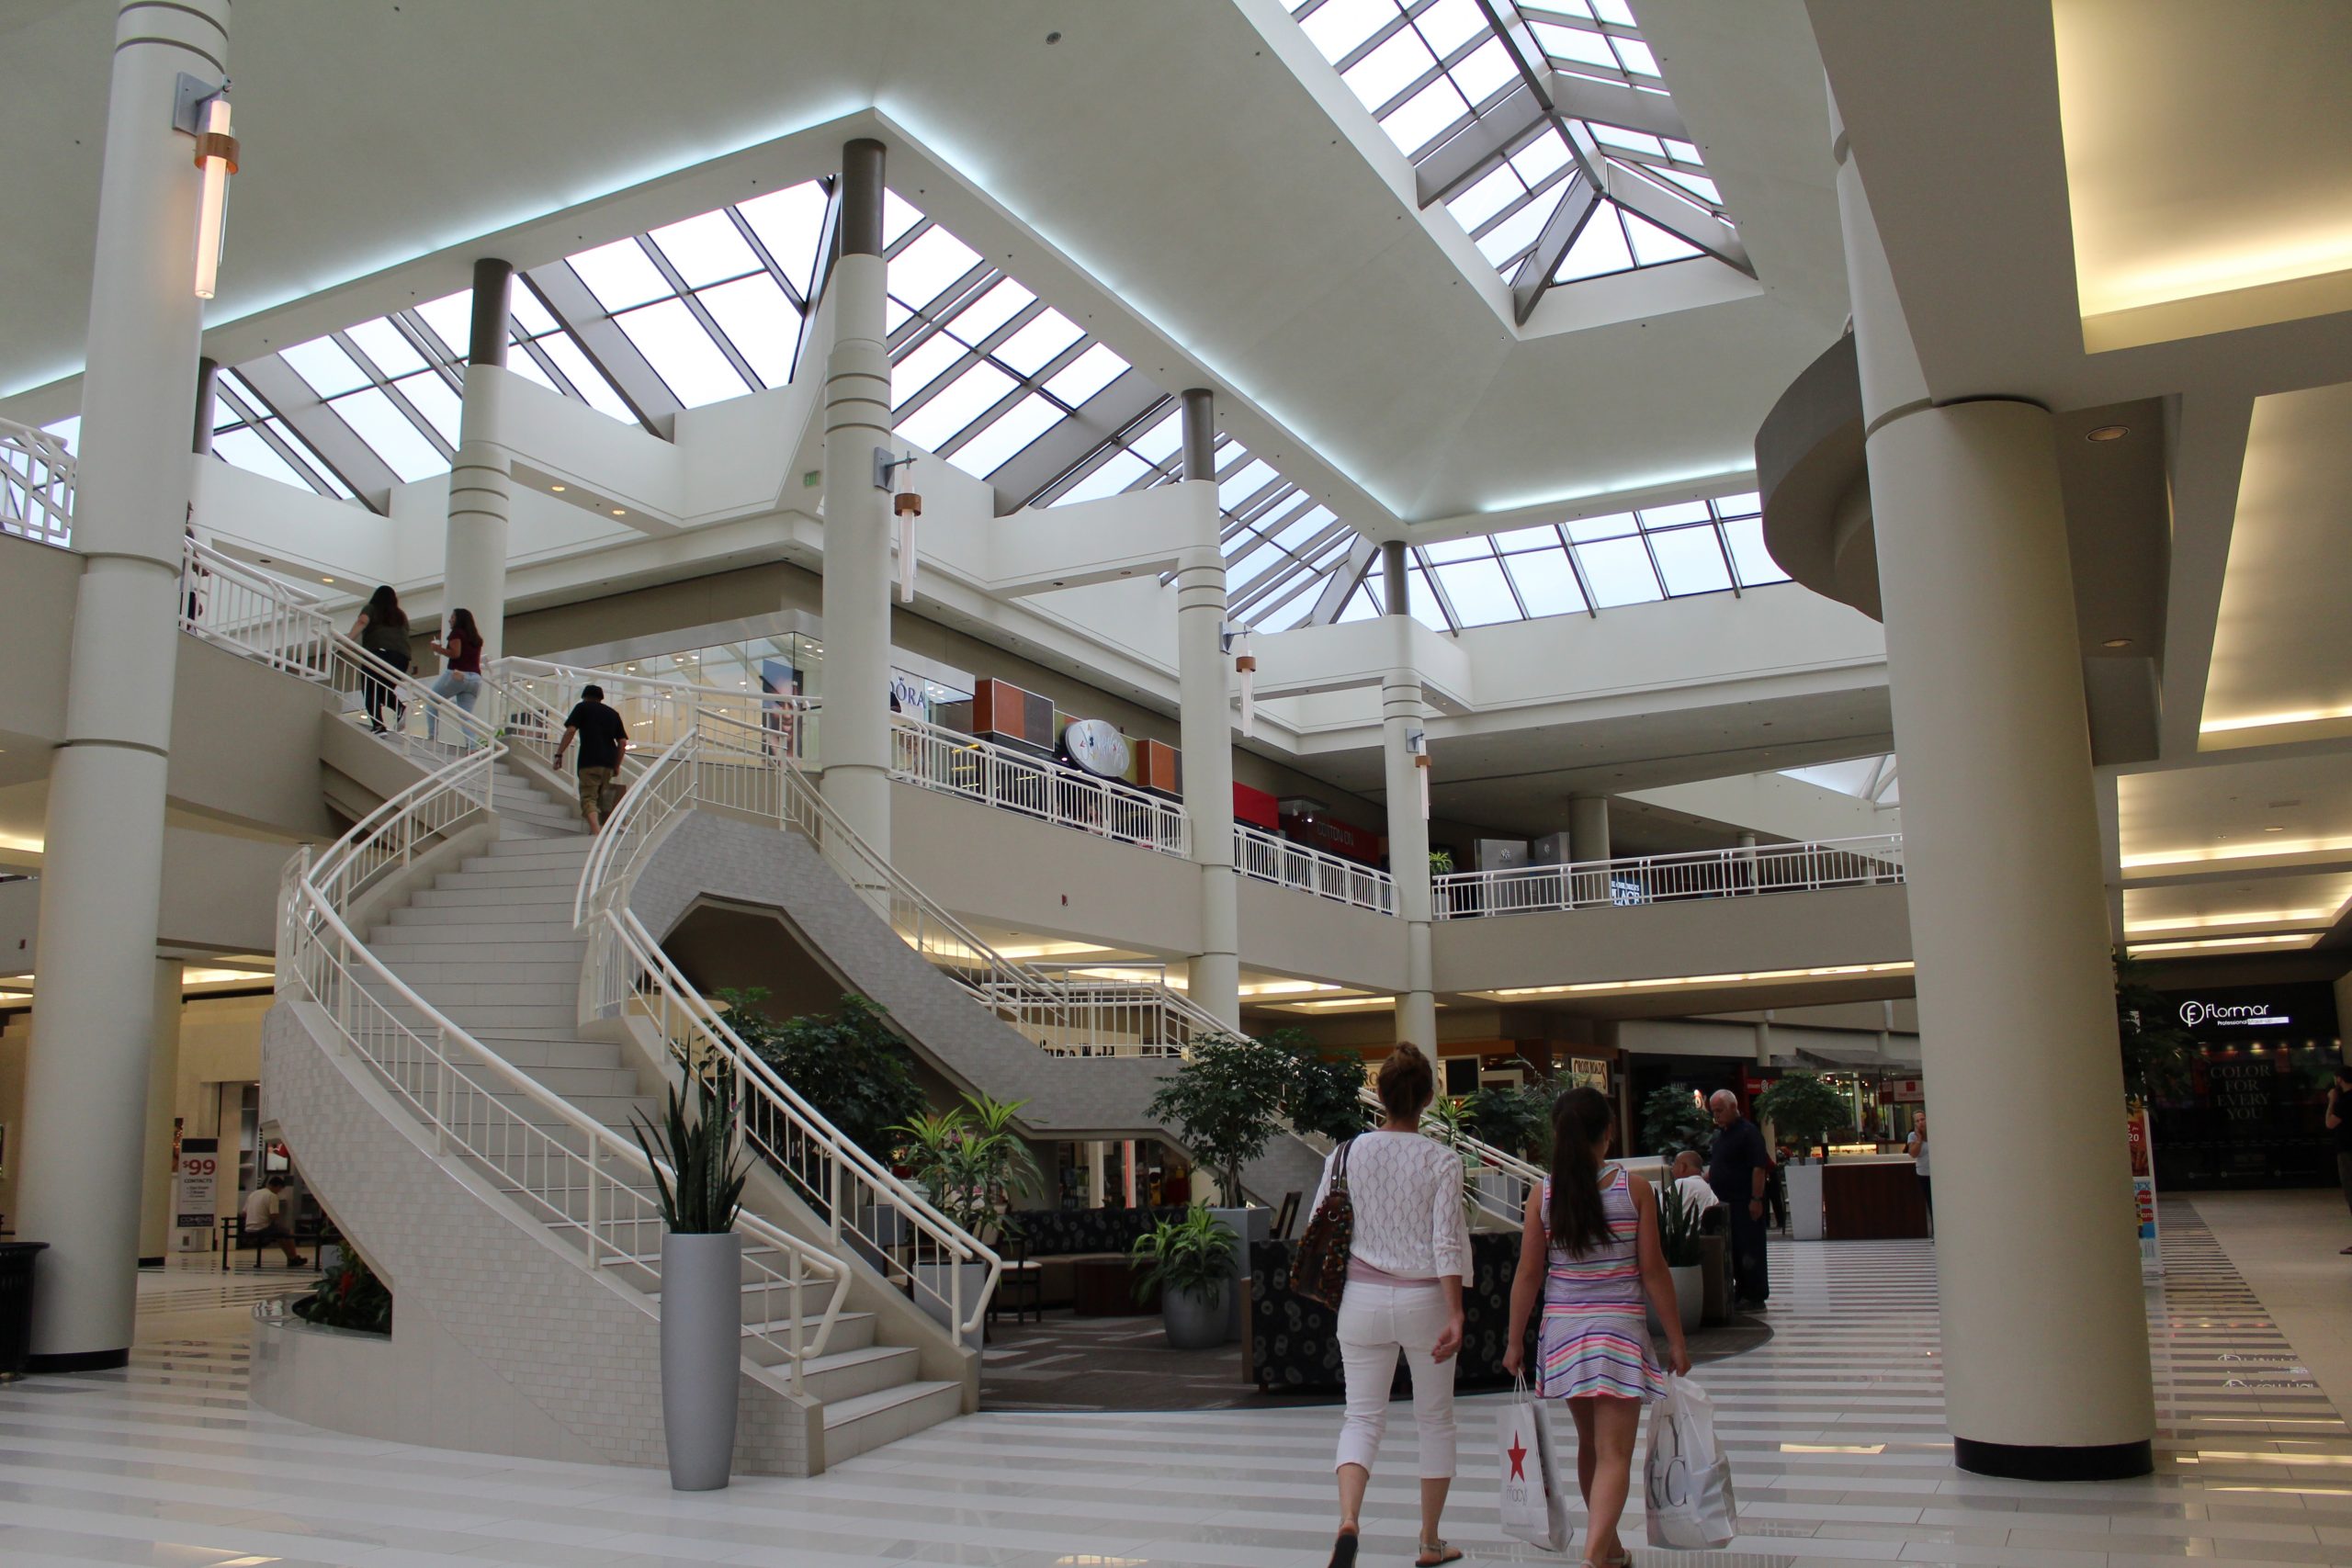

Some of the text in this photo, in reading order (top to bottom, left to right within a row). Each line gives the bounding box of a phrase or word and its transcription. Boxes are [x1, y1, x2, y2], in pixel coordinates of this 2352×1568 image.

[2206, 1003, 2269, 1019] flormar
[2210, 1065, 2272, 1079] COLOR
[2225, 1079, 2260, 1092] FOR
[2217, 1092, 2271, 1107] EVERY
[2226, 1107, 2264, 1121] YOU
[183, 1159, 216, 1176] $99
